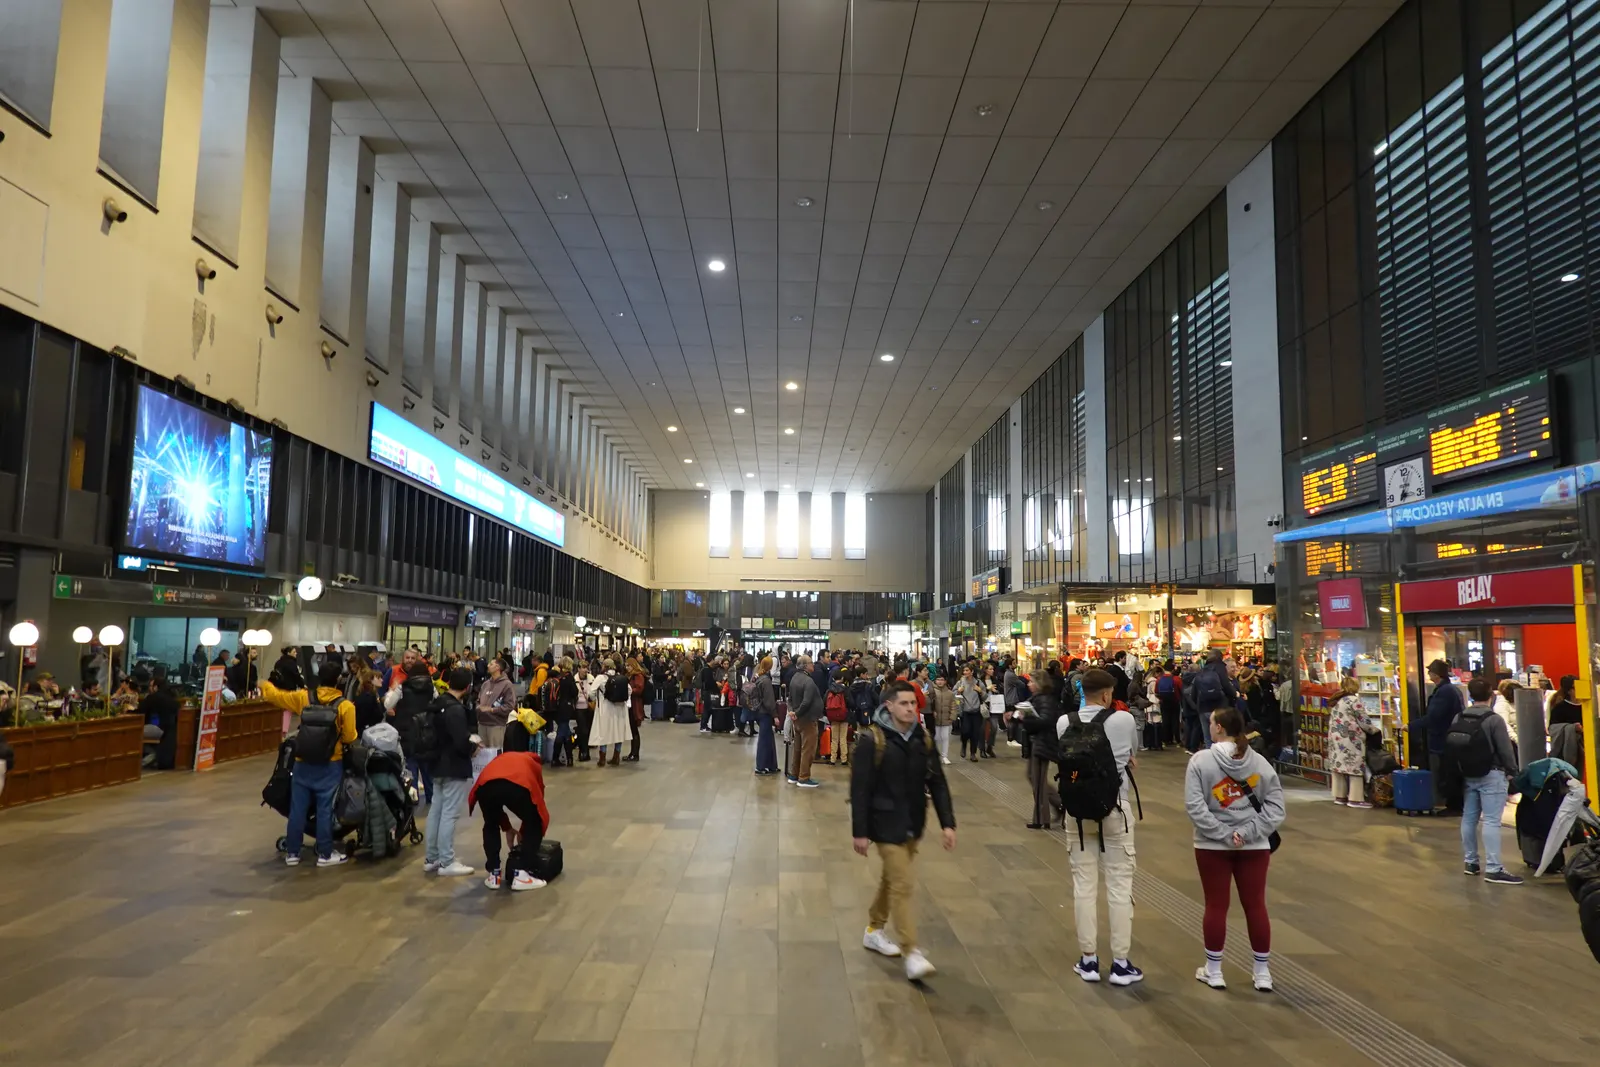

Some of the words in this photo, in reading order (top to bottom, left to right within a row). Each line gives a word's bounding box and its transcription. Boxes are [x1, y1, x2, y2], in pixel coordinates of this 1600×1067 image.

[1399, 467, 1408, 477] 12
[1416, 487, 1422, 496] 3
[1389, 494, 1395, 503] 9
[1457, 575, 1492, 606] RELAY
